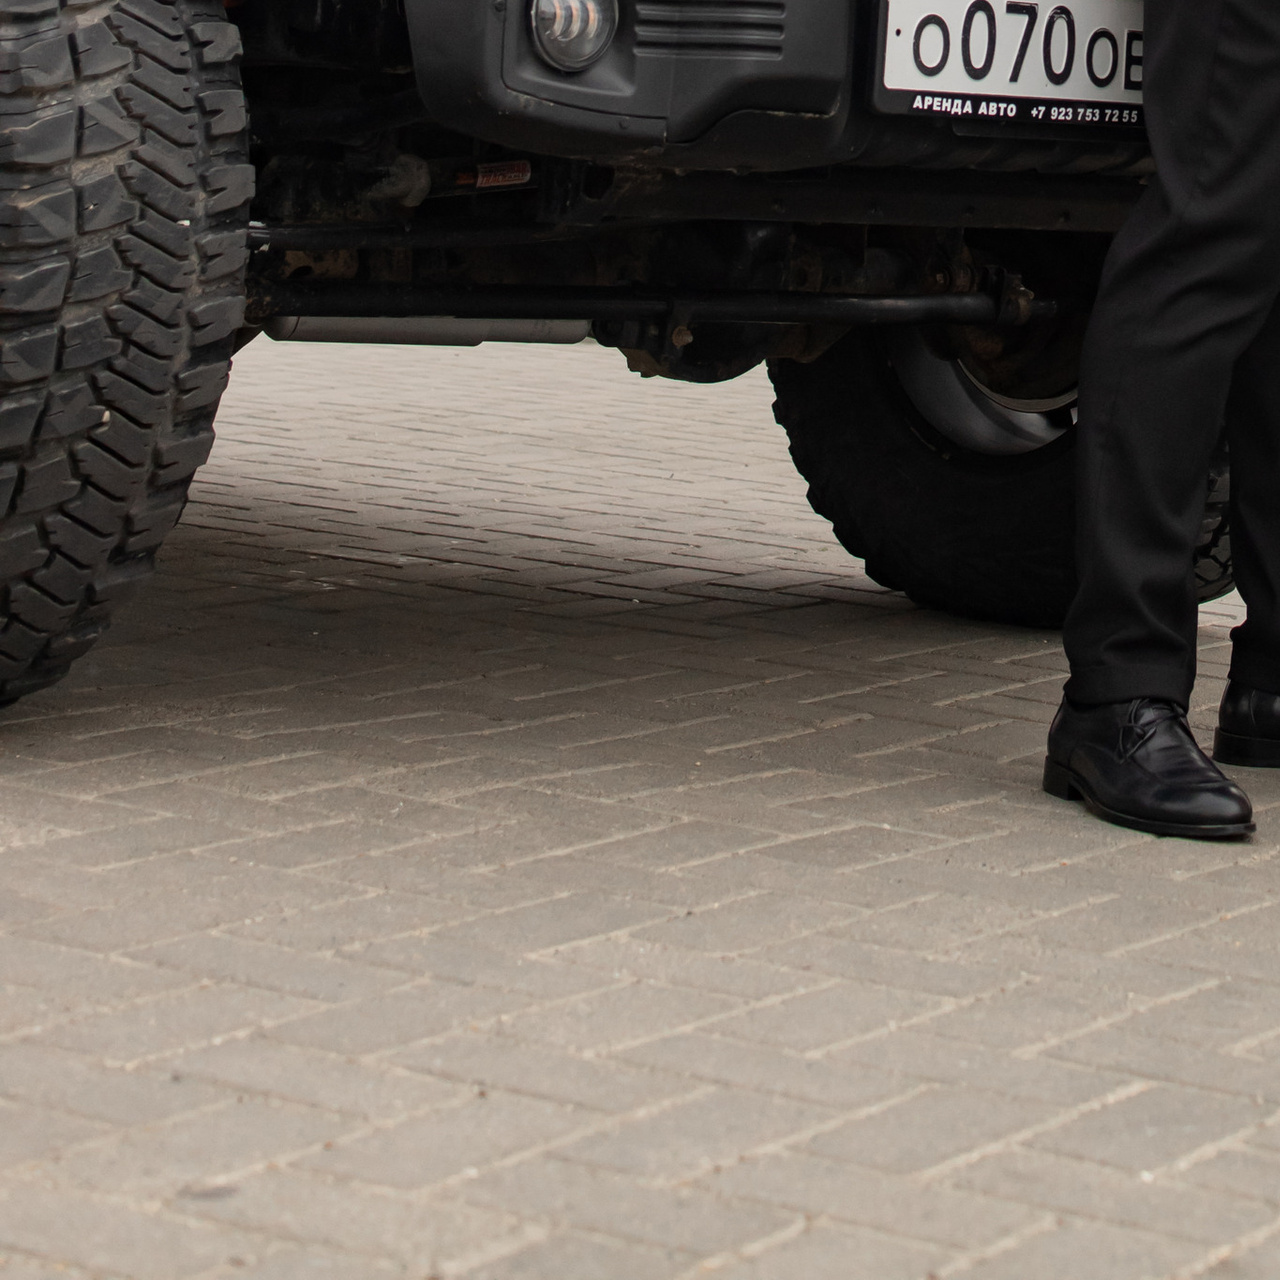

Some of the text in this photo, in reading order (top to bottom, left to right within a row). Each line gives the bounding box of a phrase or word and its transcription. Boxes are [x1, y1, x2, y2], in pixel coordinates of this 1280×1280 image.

[912, 95, 972, 115] АРЕНДА
[978, 101, 1017, 117] АВТО
[1031, 106, 1046, 119] +7
[1050, 107, 1073, 121] 923
[1077, 108, 1100, 122] 753
[1104, 109, 1119, 122] 72
